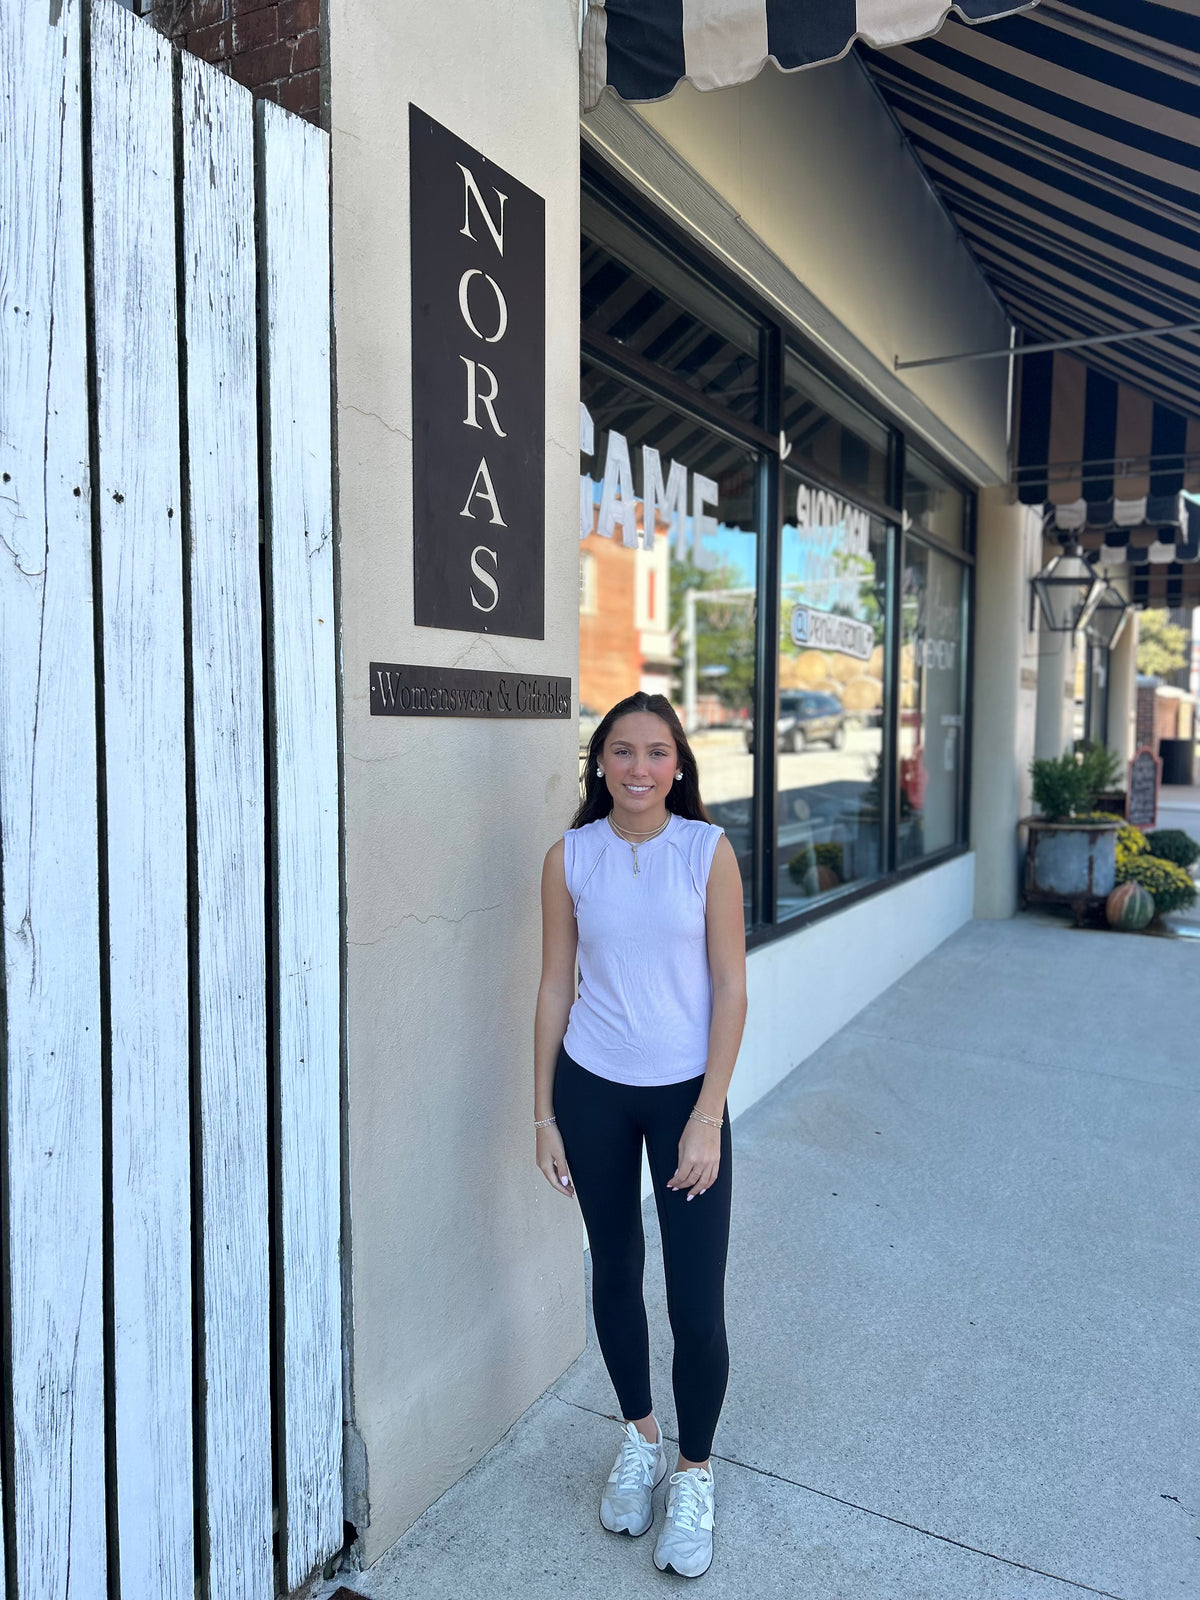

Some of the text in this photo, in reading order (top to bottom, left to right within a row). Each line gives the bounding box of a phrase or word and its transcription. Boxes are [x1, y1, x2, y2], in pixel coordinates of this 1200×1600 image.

[455, 160, 509, 613] NORAS
[376, 670, 570, 714] Womenswear & Giftables
